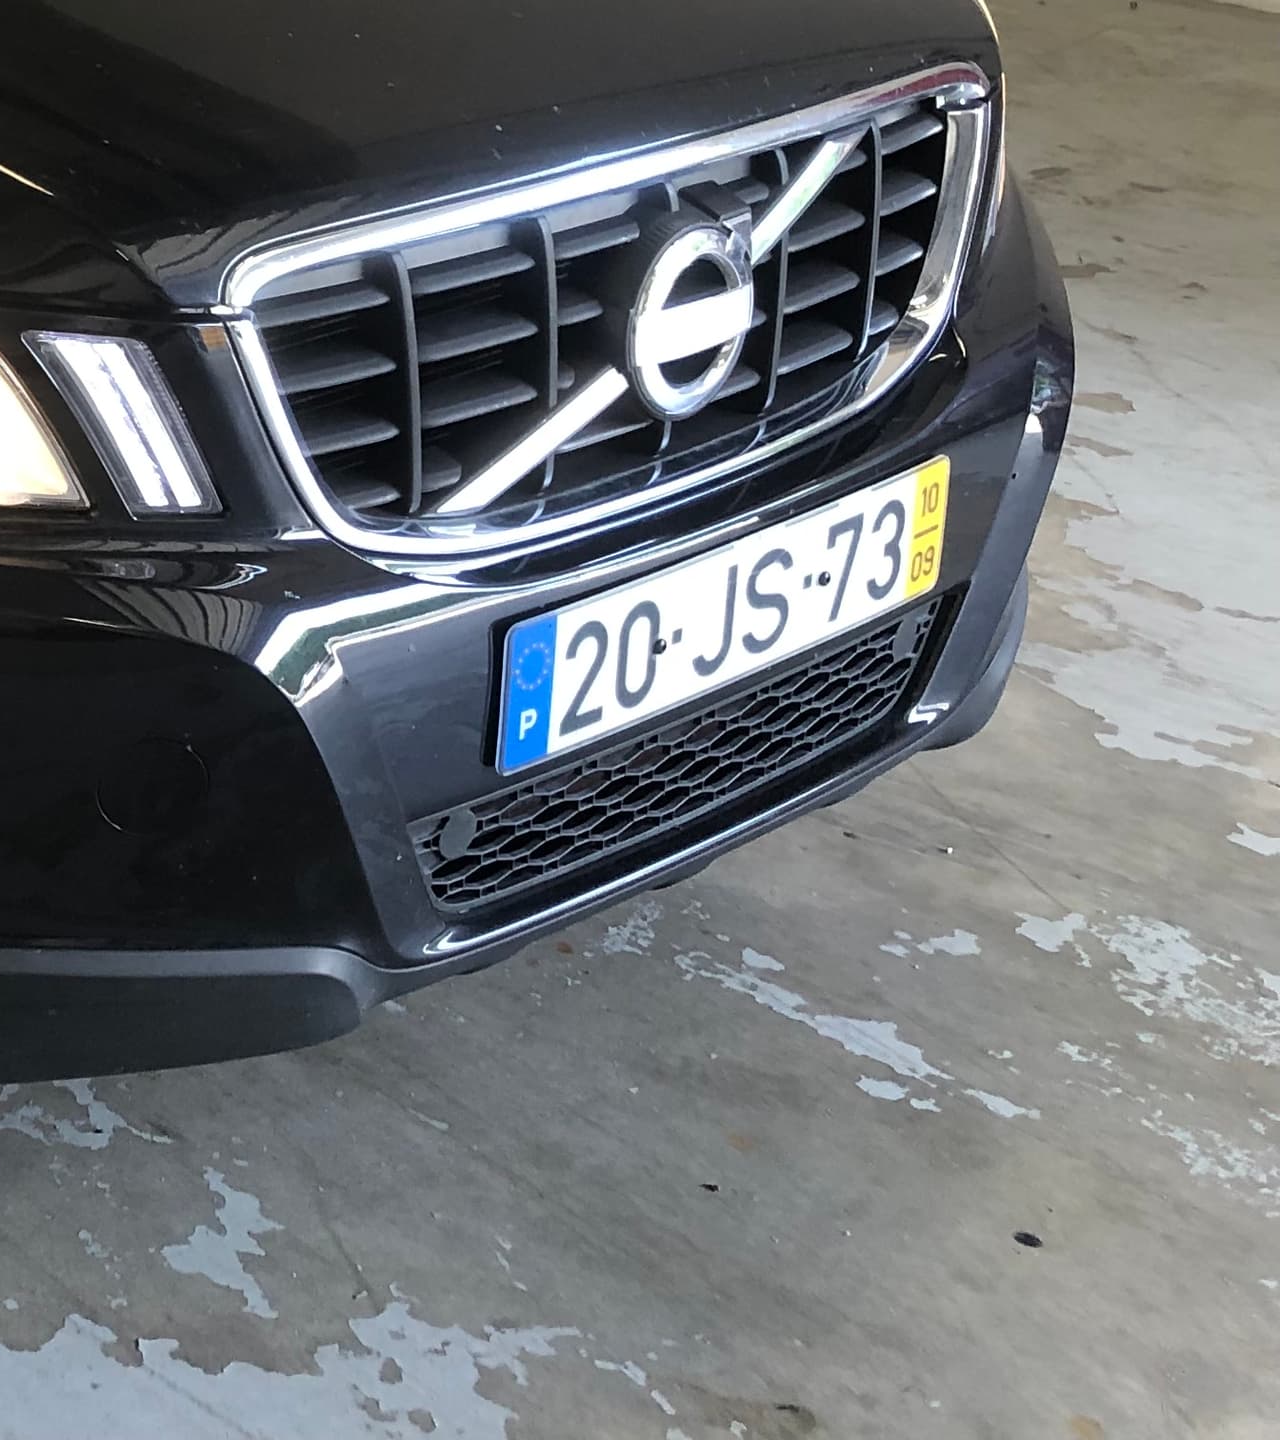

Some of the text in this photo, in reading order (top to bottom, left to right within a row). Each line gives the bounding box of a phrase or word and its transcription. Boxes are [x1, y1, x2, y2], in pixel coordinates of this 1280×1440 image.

[921, 482, 939, 515] 10
[910, 546, 935, 582] 09
[519, 710, 537, 741] P
